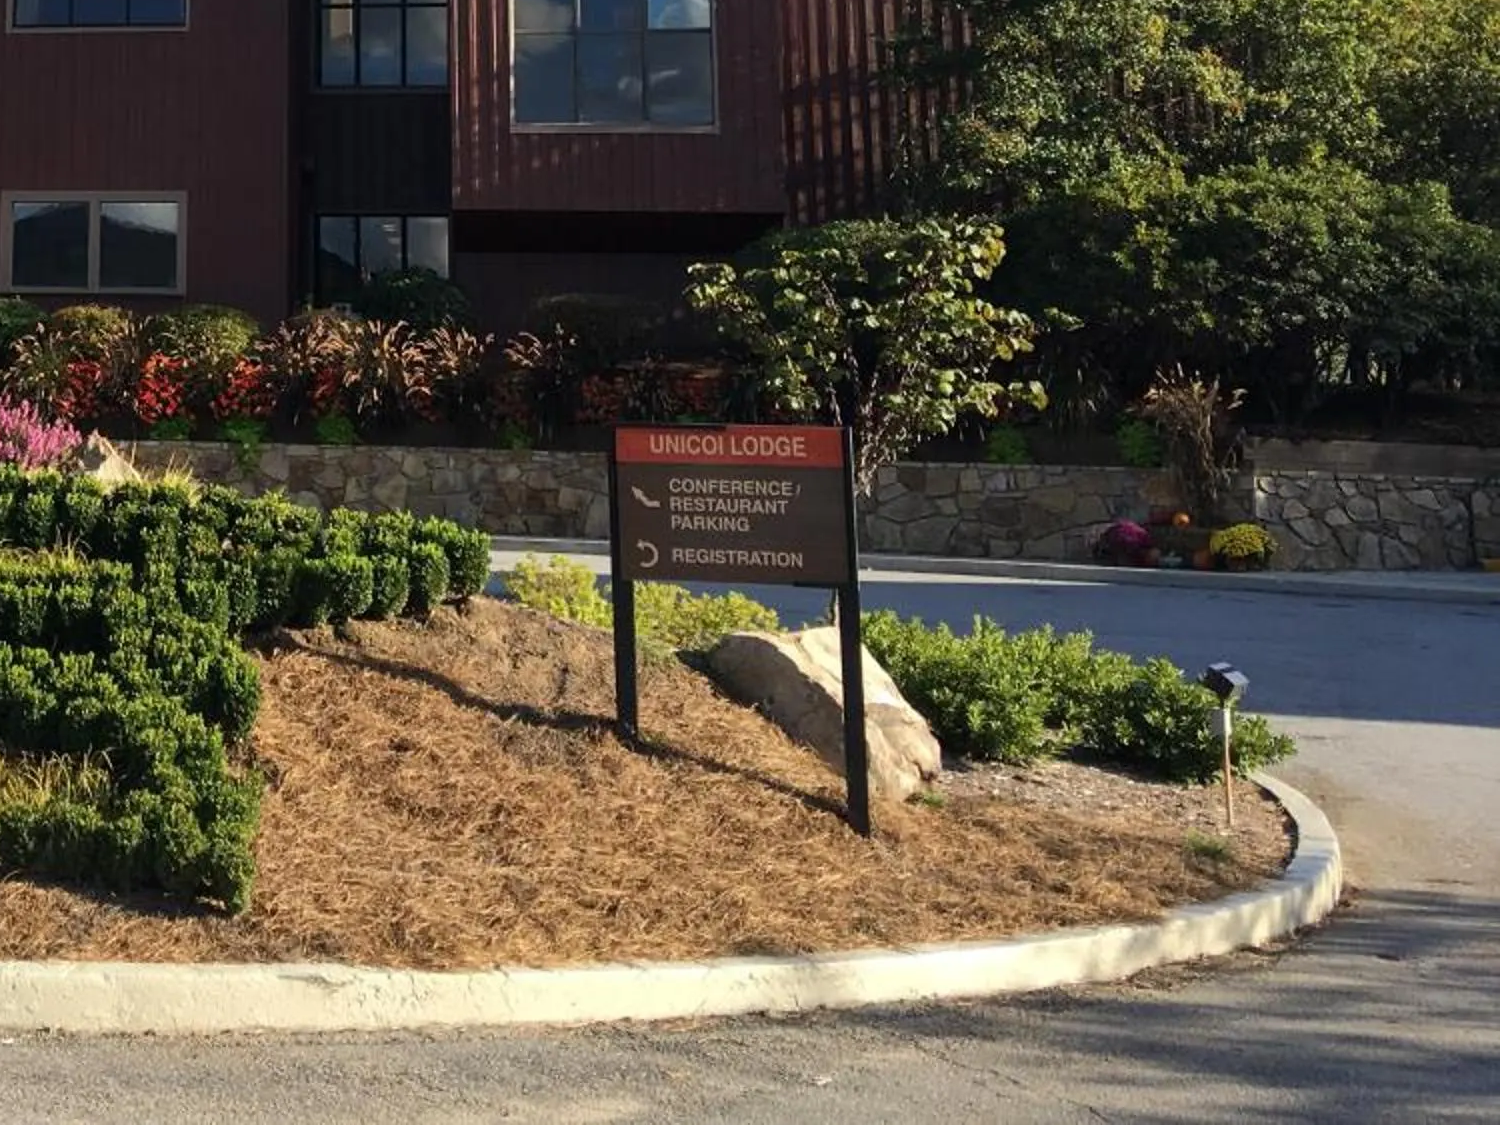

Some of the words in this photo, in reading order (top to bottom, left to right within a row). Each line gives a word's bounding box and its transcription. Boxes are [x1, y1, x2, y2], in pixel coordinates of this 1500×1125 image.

[650, 435, 724, 456] UNICOI
[731, 436, 807, 457] LODGE
[669, 497, 789, 515] RESTAURANT
[671, 515, 750, 532] PARKING
[672, 548, 804, 568] REGISTRATION
